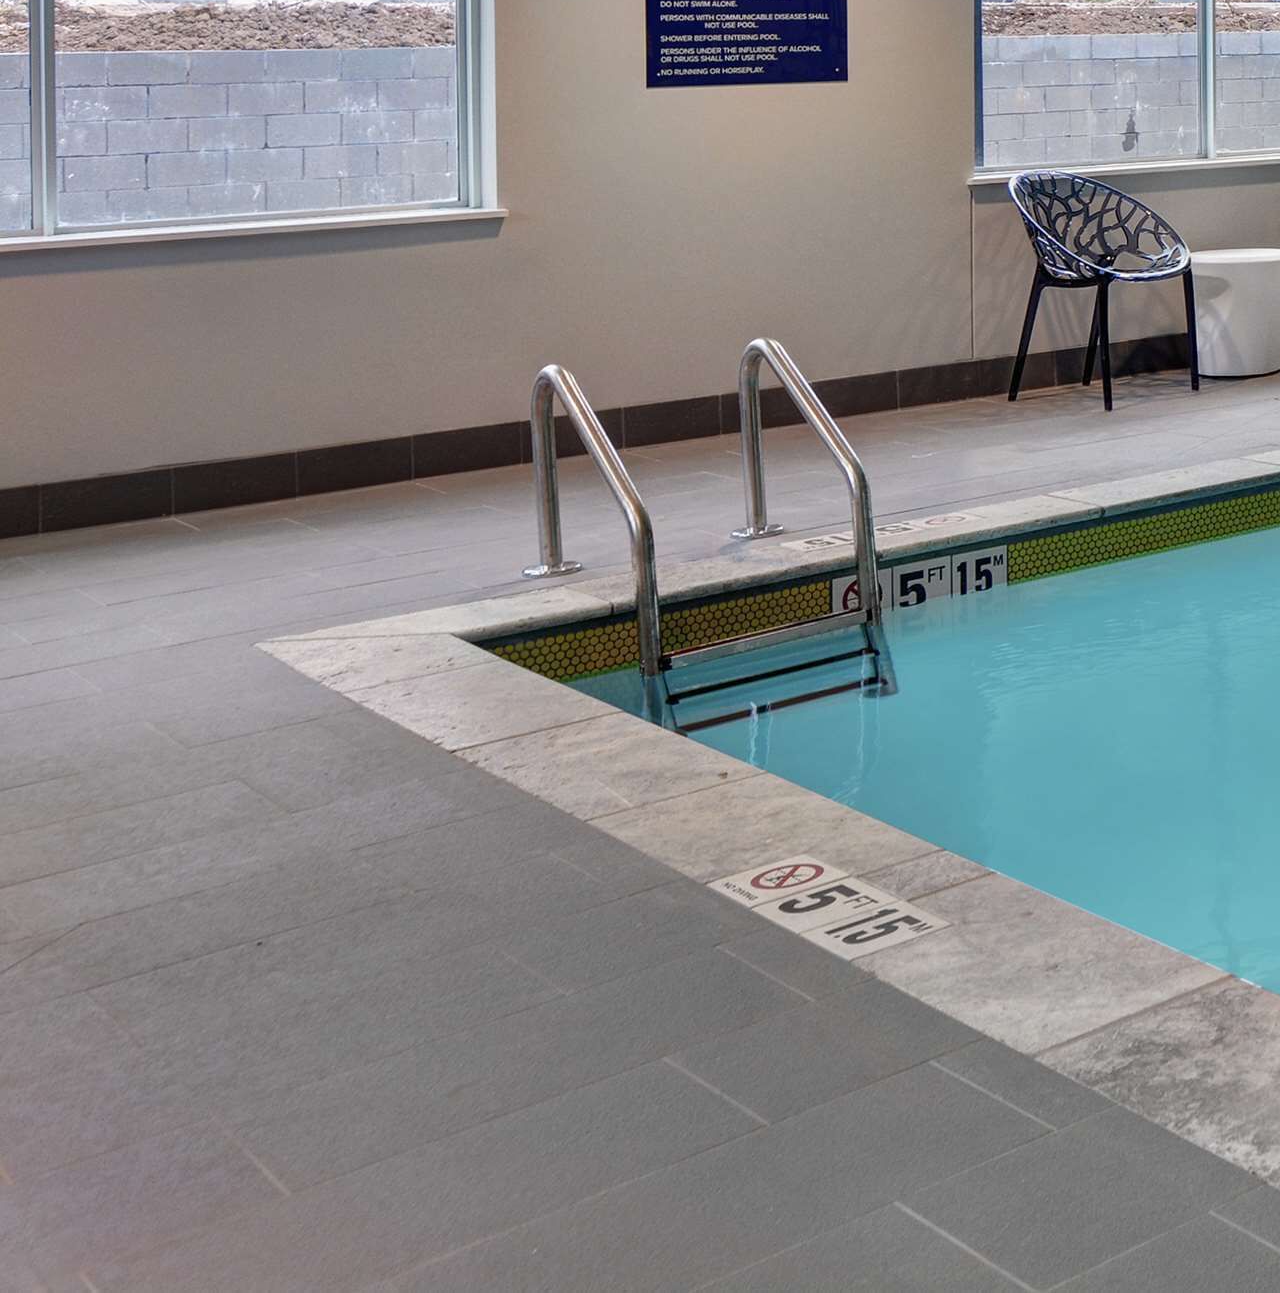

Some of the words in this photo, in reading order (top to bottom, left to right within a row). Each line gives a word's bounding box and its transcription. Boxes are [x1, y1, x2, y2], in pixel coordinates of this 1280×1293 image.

[690, 0, 711, 8] SWIM
[660, 14, 695, 22] PERSONS
[773, 13, 807, 21] DISEASES
[723, 34, 759, 42] ENTERING
[696, 47, 722, 55] UNDER
[738, 46, 777, 54] INFLUENCE
[789, 45, 821, 53] ALCOHOL
[673, 55, 700, 63] DRUGS
